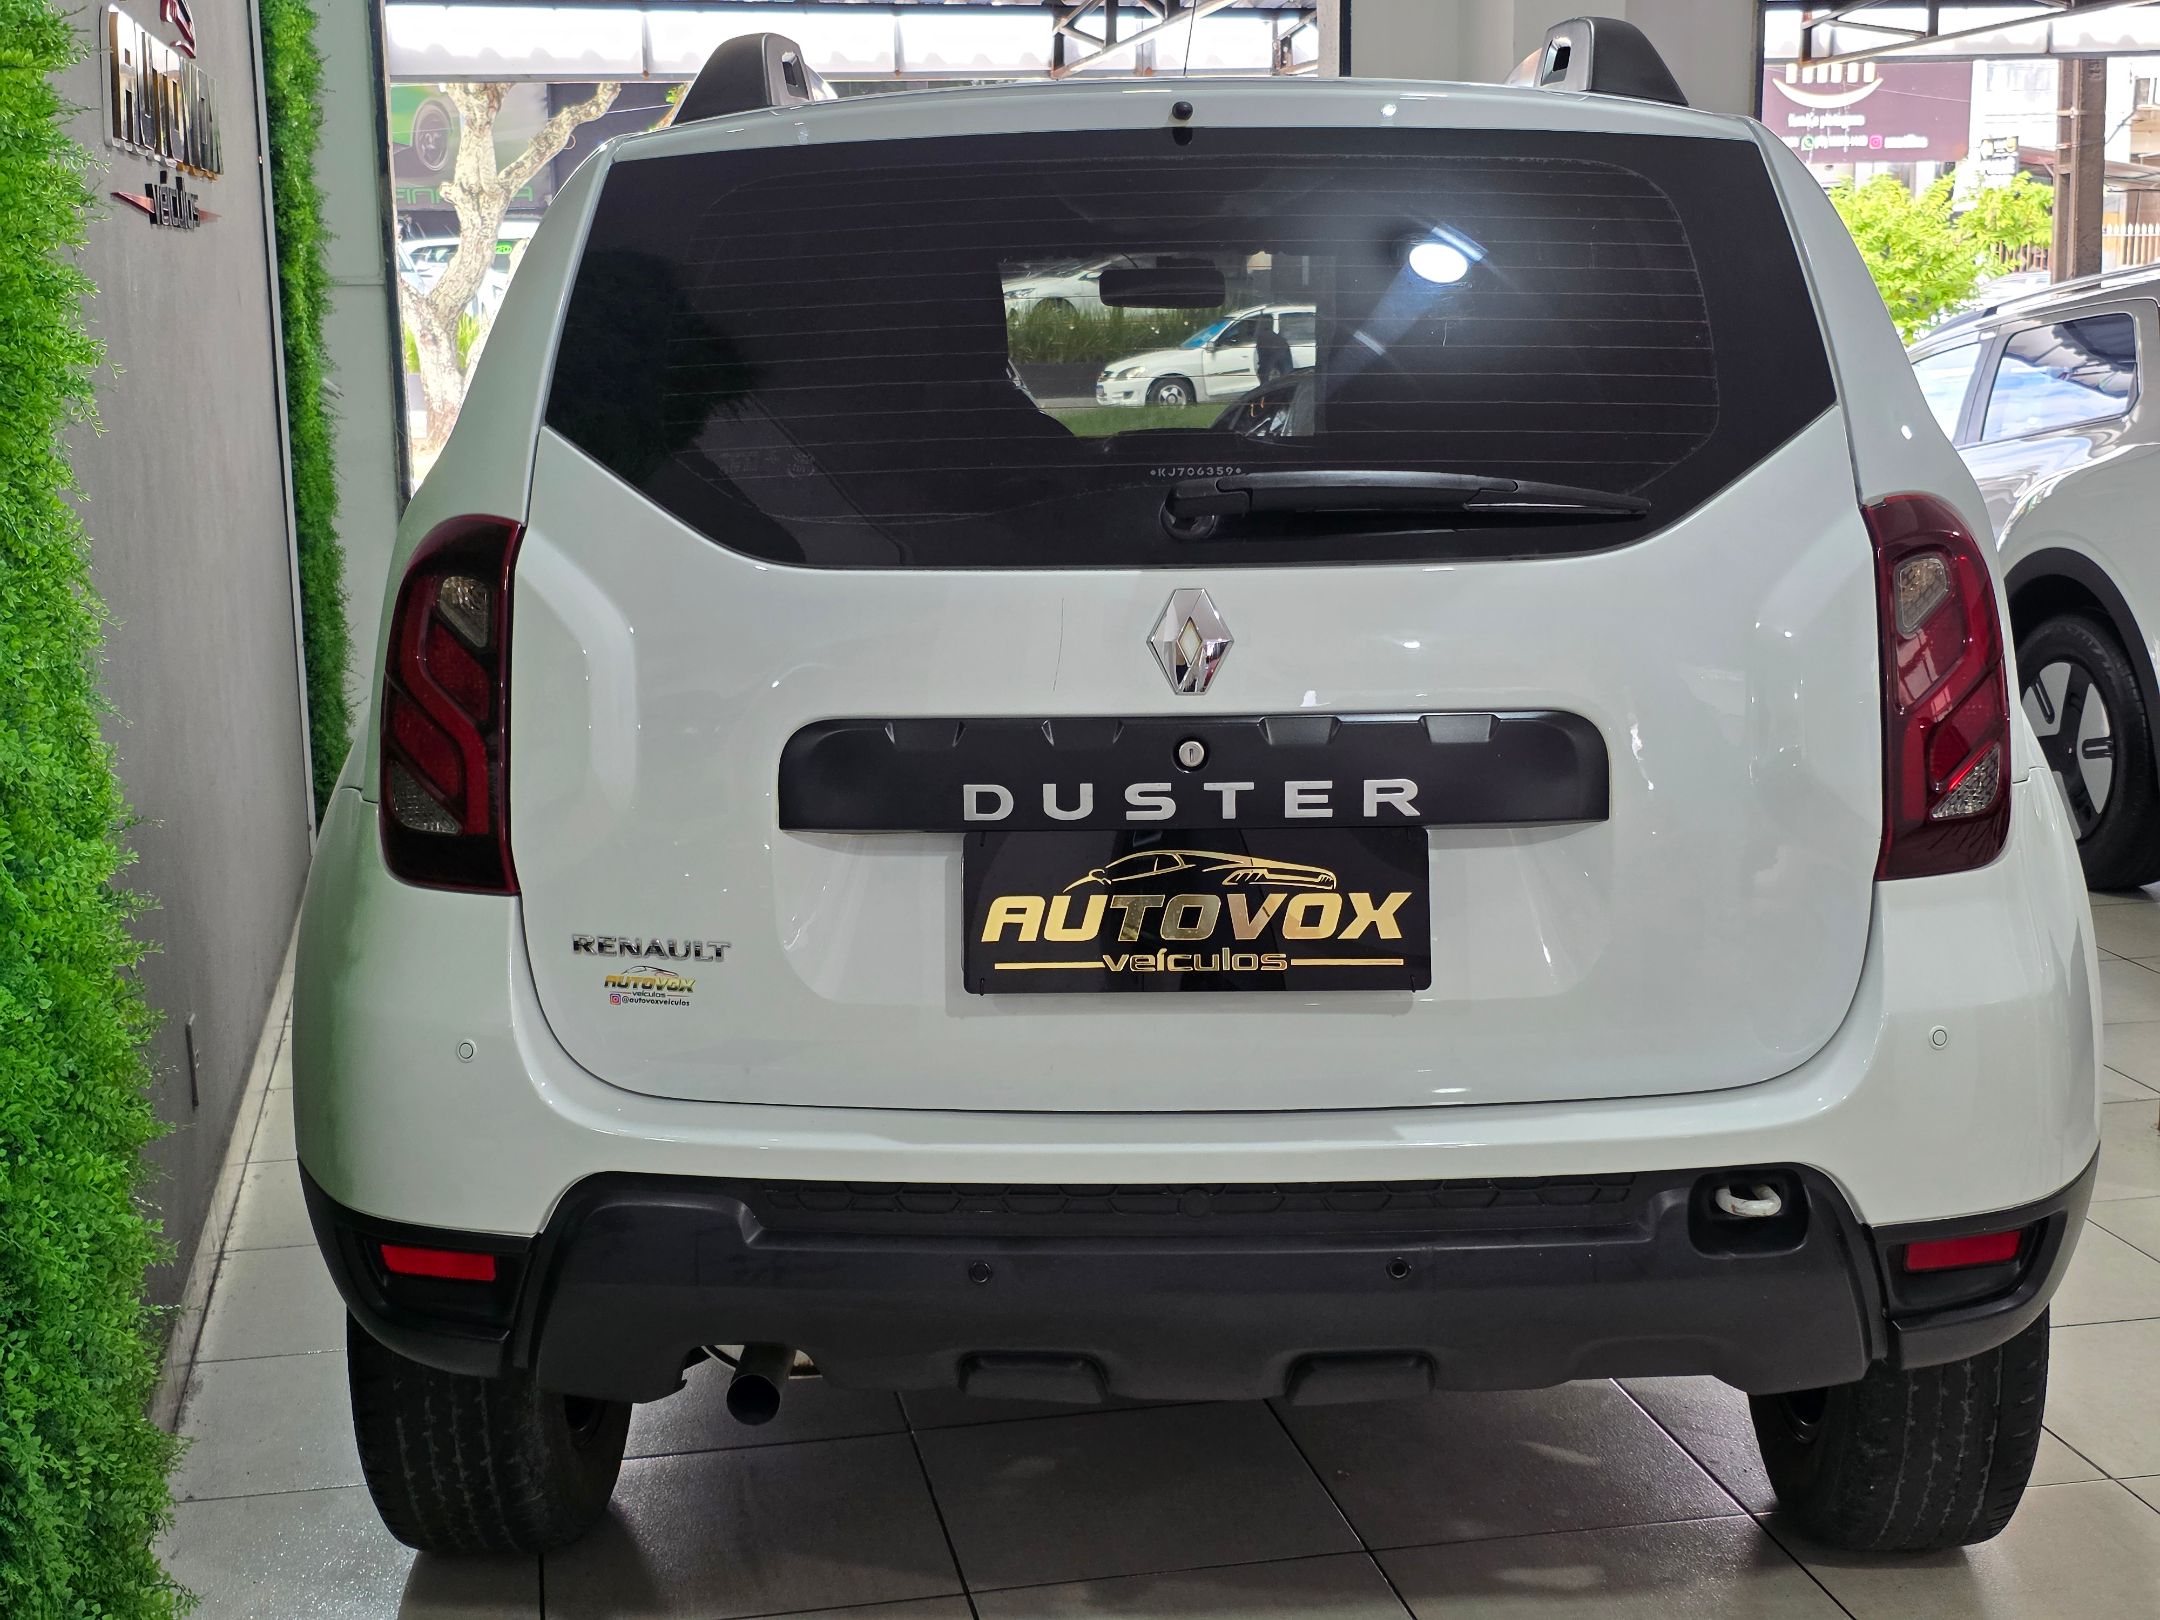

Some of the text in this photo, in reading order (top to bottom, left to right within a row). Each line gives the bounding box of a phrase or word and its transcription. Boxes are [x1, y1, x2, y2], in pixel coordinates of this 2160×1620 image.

[1158, 467, 1234, 477] KJ706359
[963, 779, 1422, 822] DUSTER
[981, 892, 1412, 943] AUTOVOX
[572, 934, 732, 962] RENAULT
[1103, 948, 1288, 973] veículos
[604, 974, 696, 993] AUTOVOX
